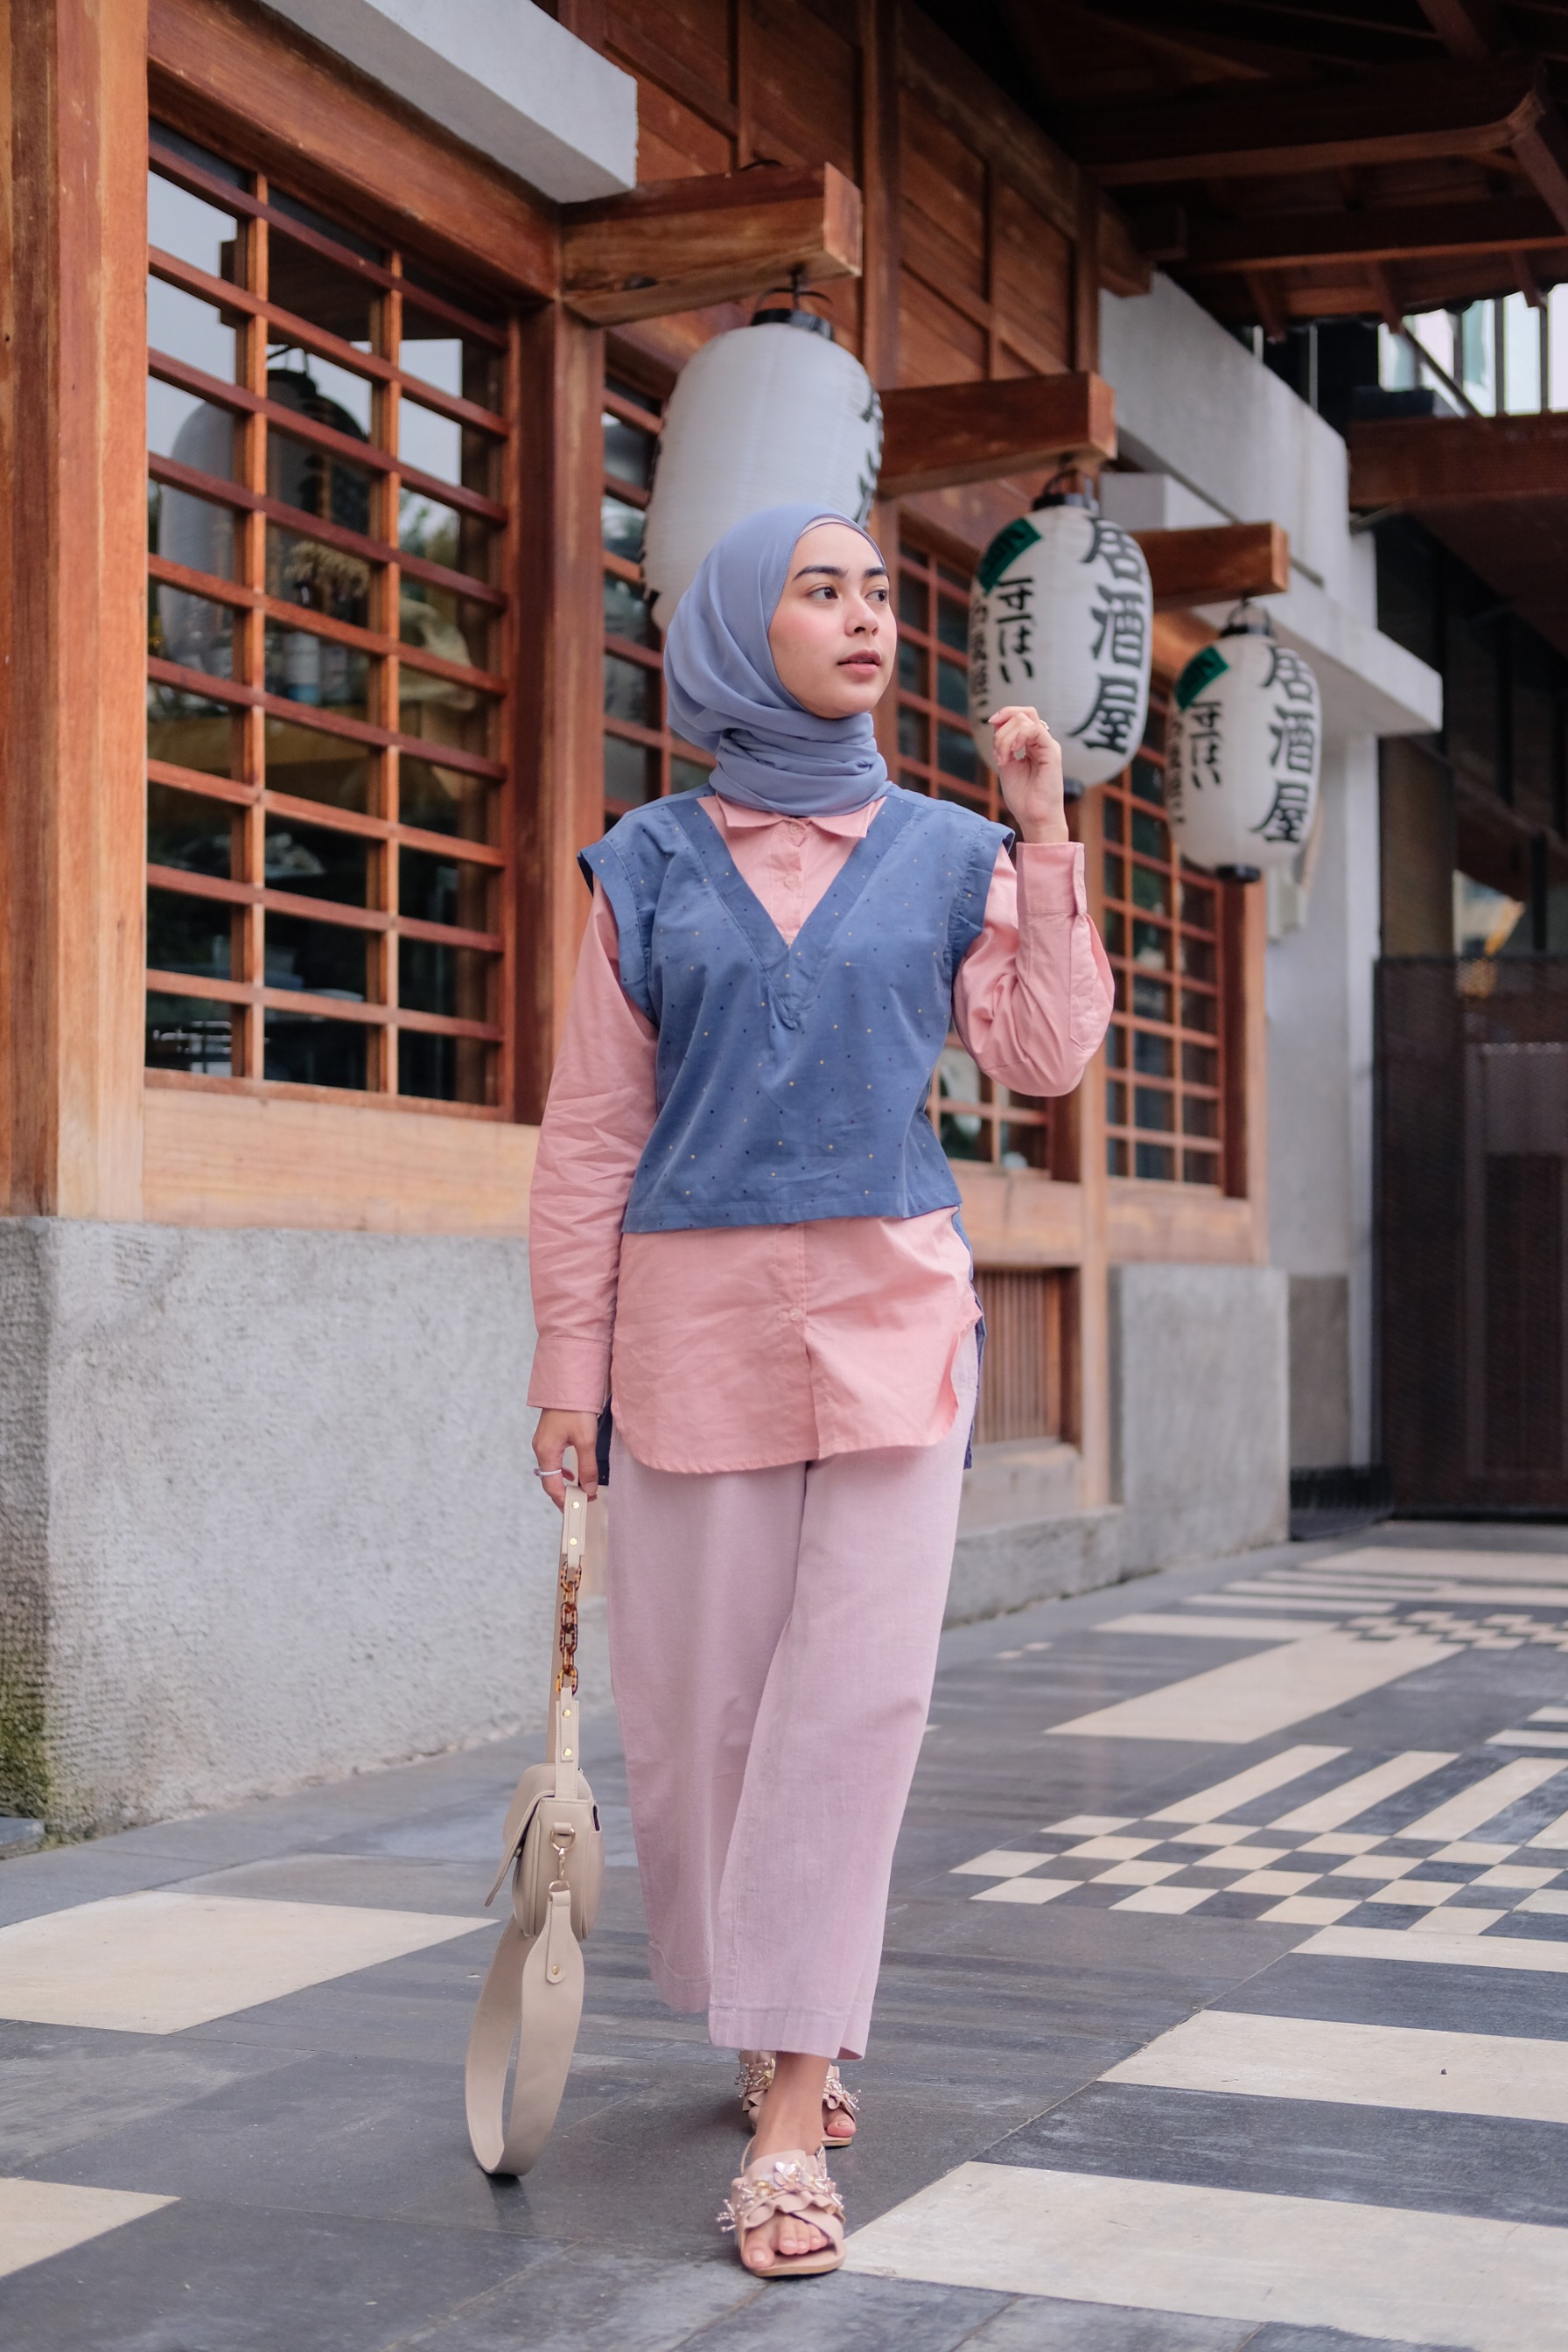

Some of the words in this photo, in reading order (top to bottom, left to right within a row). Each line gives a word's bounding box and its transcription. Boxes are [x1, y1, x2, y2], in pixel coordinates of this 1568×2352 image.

[1068, 517, 1144, 754] 居酒屋
[1249, 643, 1313, 843] 居酒屋
